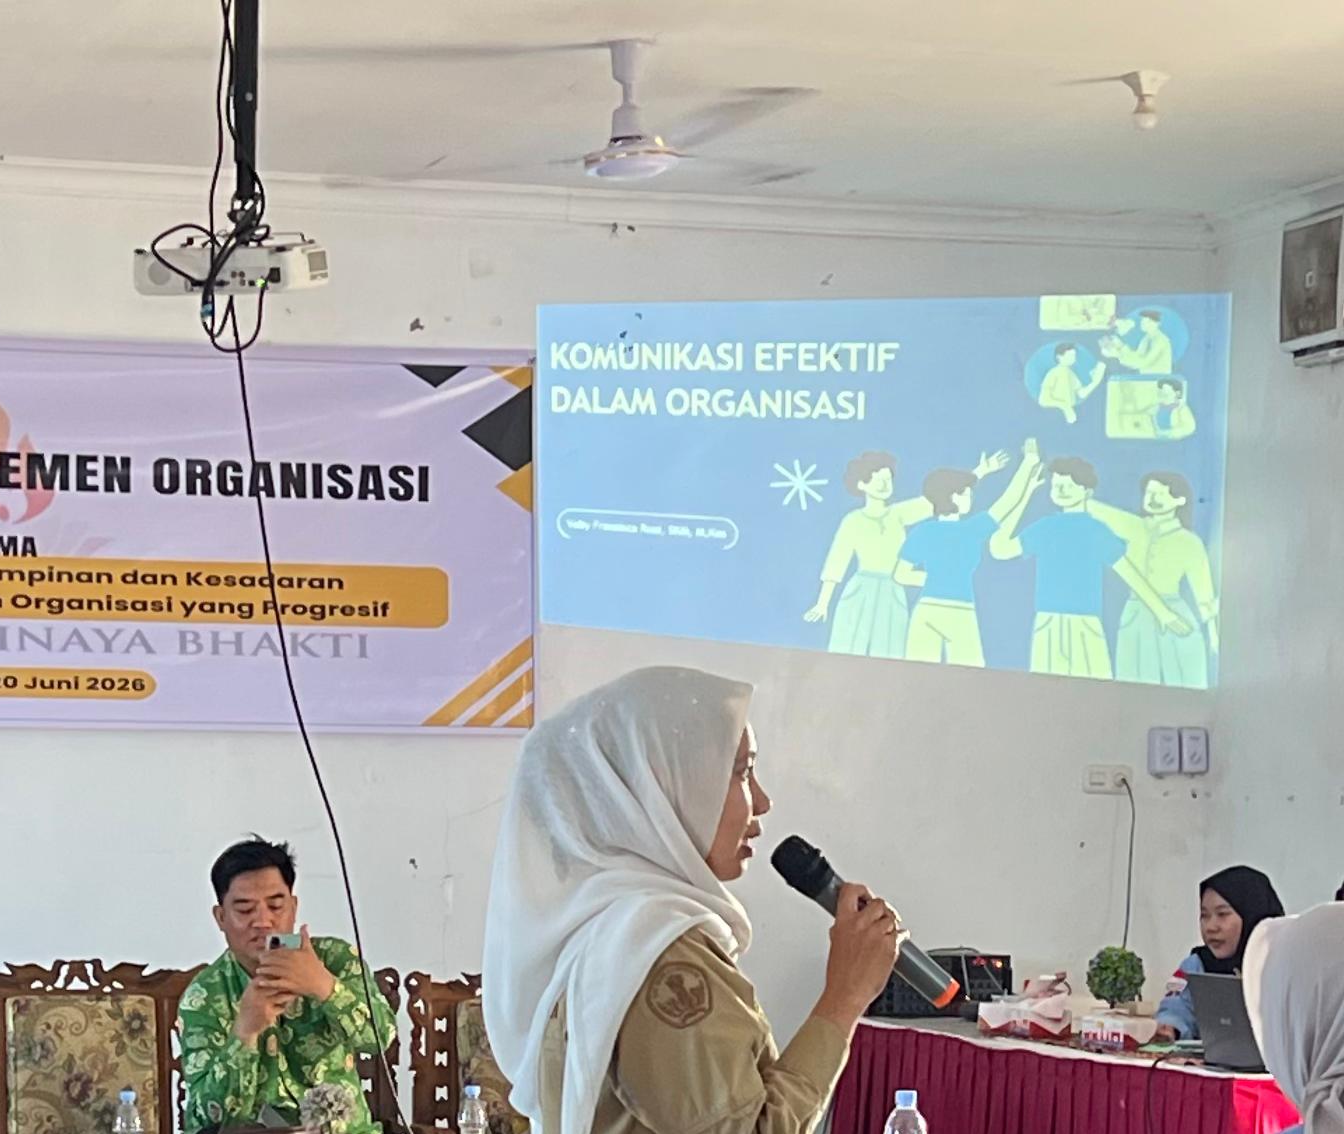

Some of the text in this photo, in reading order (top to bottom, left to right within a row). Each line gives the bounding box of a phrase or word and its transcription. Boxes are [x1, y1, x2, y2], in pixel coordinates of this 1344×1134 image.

[551, 342, 899, 372] KOMUNIKASI EFEKTIF
[552, 386, 865, 420] DALAM ORGANISASI
[152, 458, 430, 502] ORGANISASI
[121, 570, 177, 585] dan
[186, 570, 344, 590] Kesadaran
[11, 595, 172, 614] Organisasi
[181, 601, 253, 619] yang
[263, 600, 390, 621] Progresif
[178, 630, 370, 660] BHAKTI
[24, 676, 79, 690] Juni
[87, 678, 145, 691] 2026
